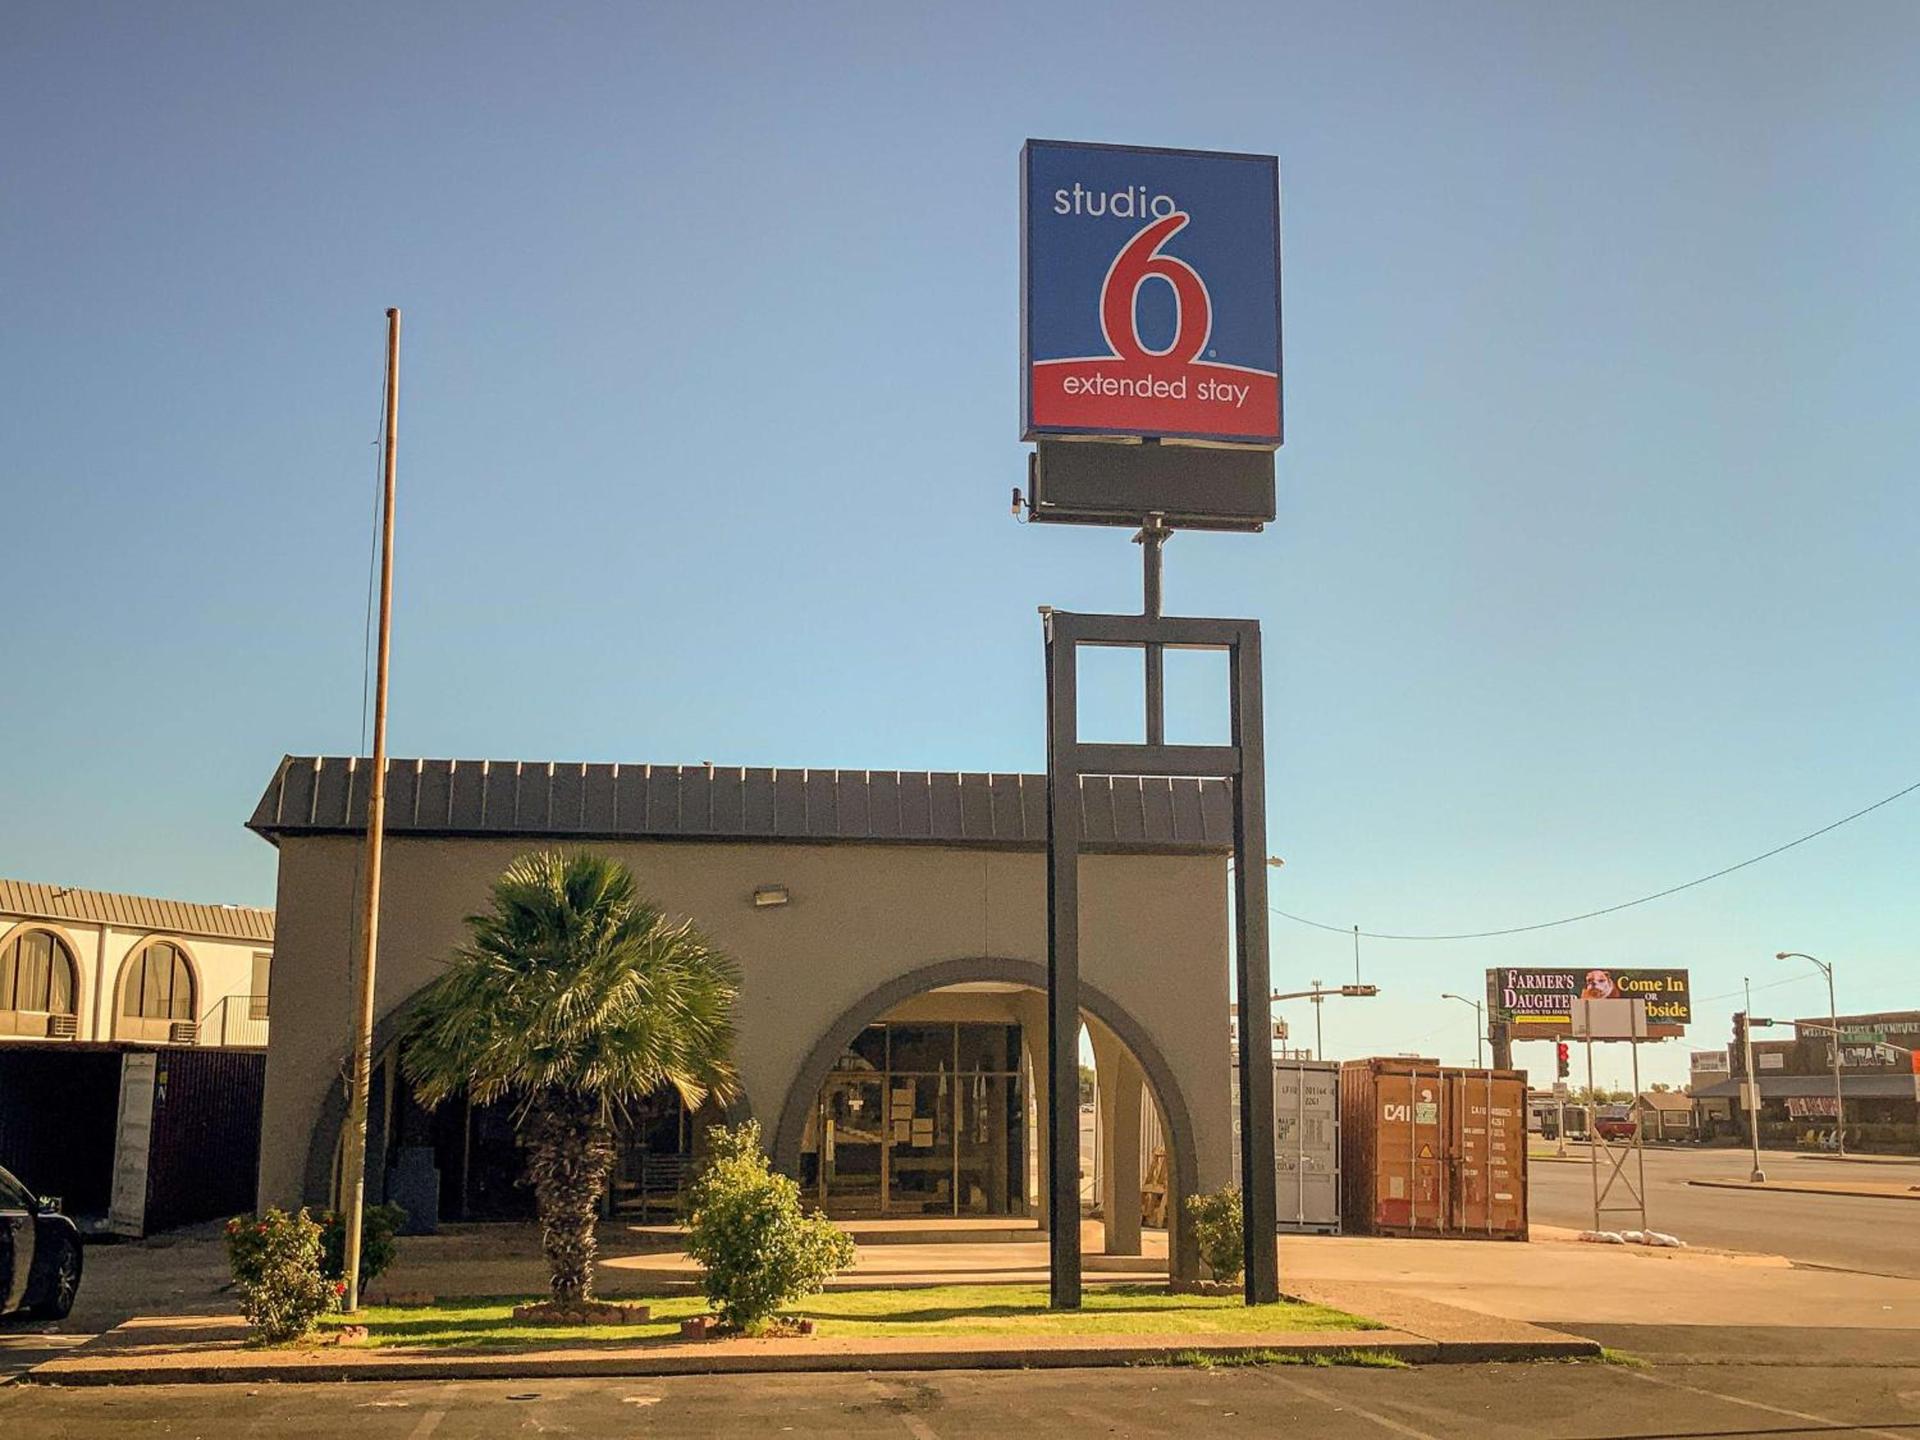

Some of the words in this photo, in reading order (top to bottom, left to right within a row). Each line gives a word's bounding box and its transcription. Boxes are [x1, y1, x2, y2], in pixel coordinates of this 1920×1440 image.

[1054, 183, 1176, 219] studio
[1099, 211, 1213, 364] 6
[1063, 372, 1187, 400] extended
[1197, 377, 1251, 408] stay
[1507, 969, 1575, 989] FARMER'S
[1616, 975, 1664, 992] Come
[1665, 976, 1685, 992] In
[1644, 993, 1658, 1001] OR
[1384, 1104, 1411, 1122] CAI
